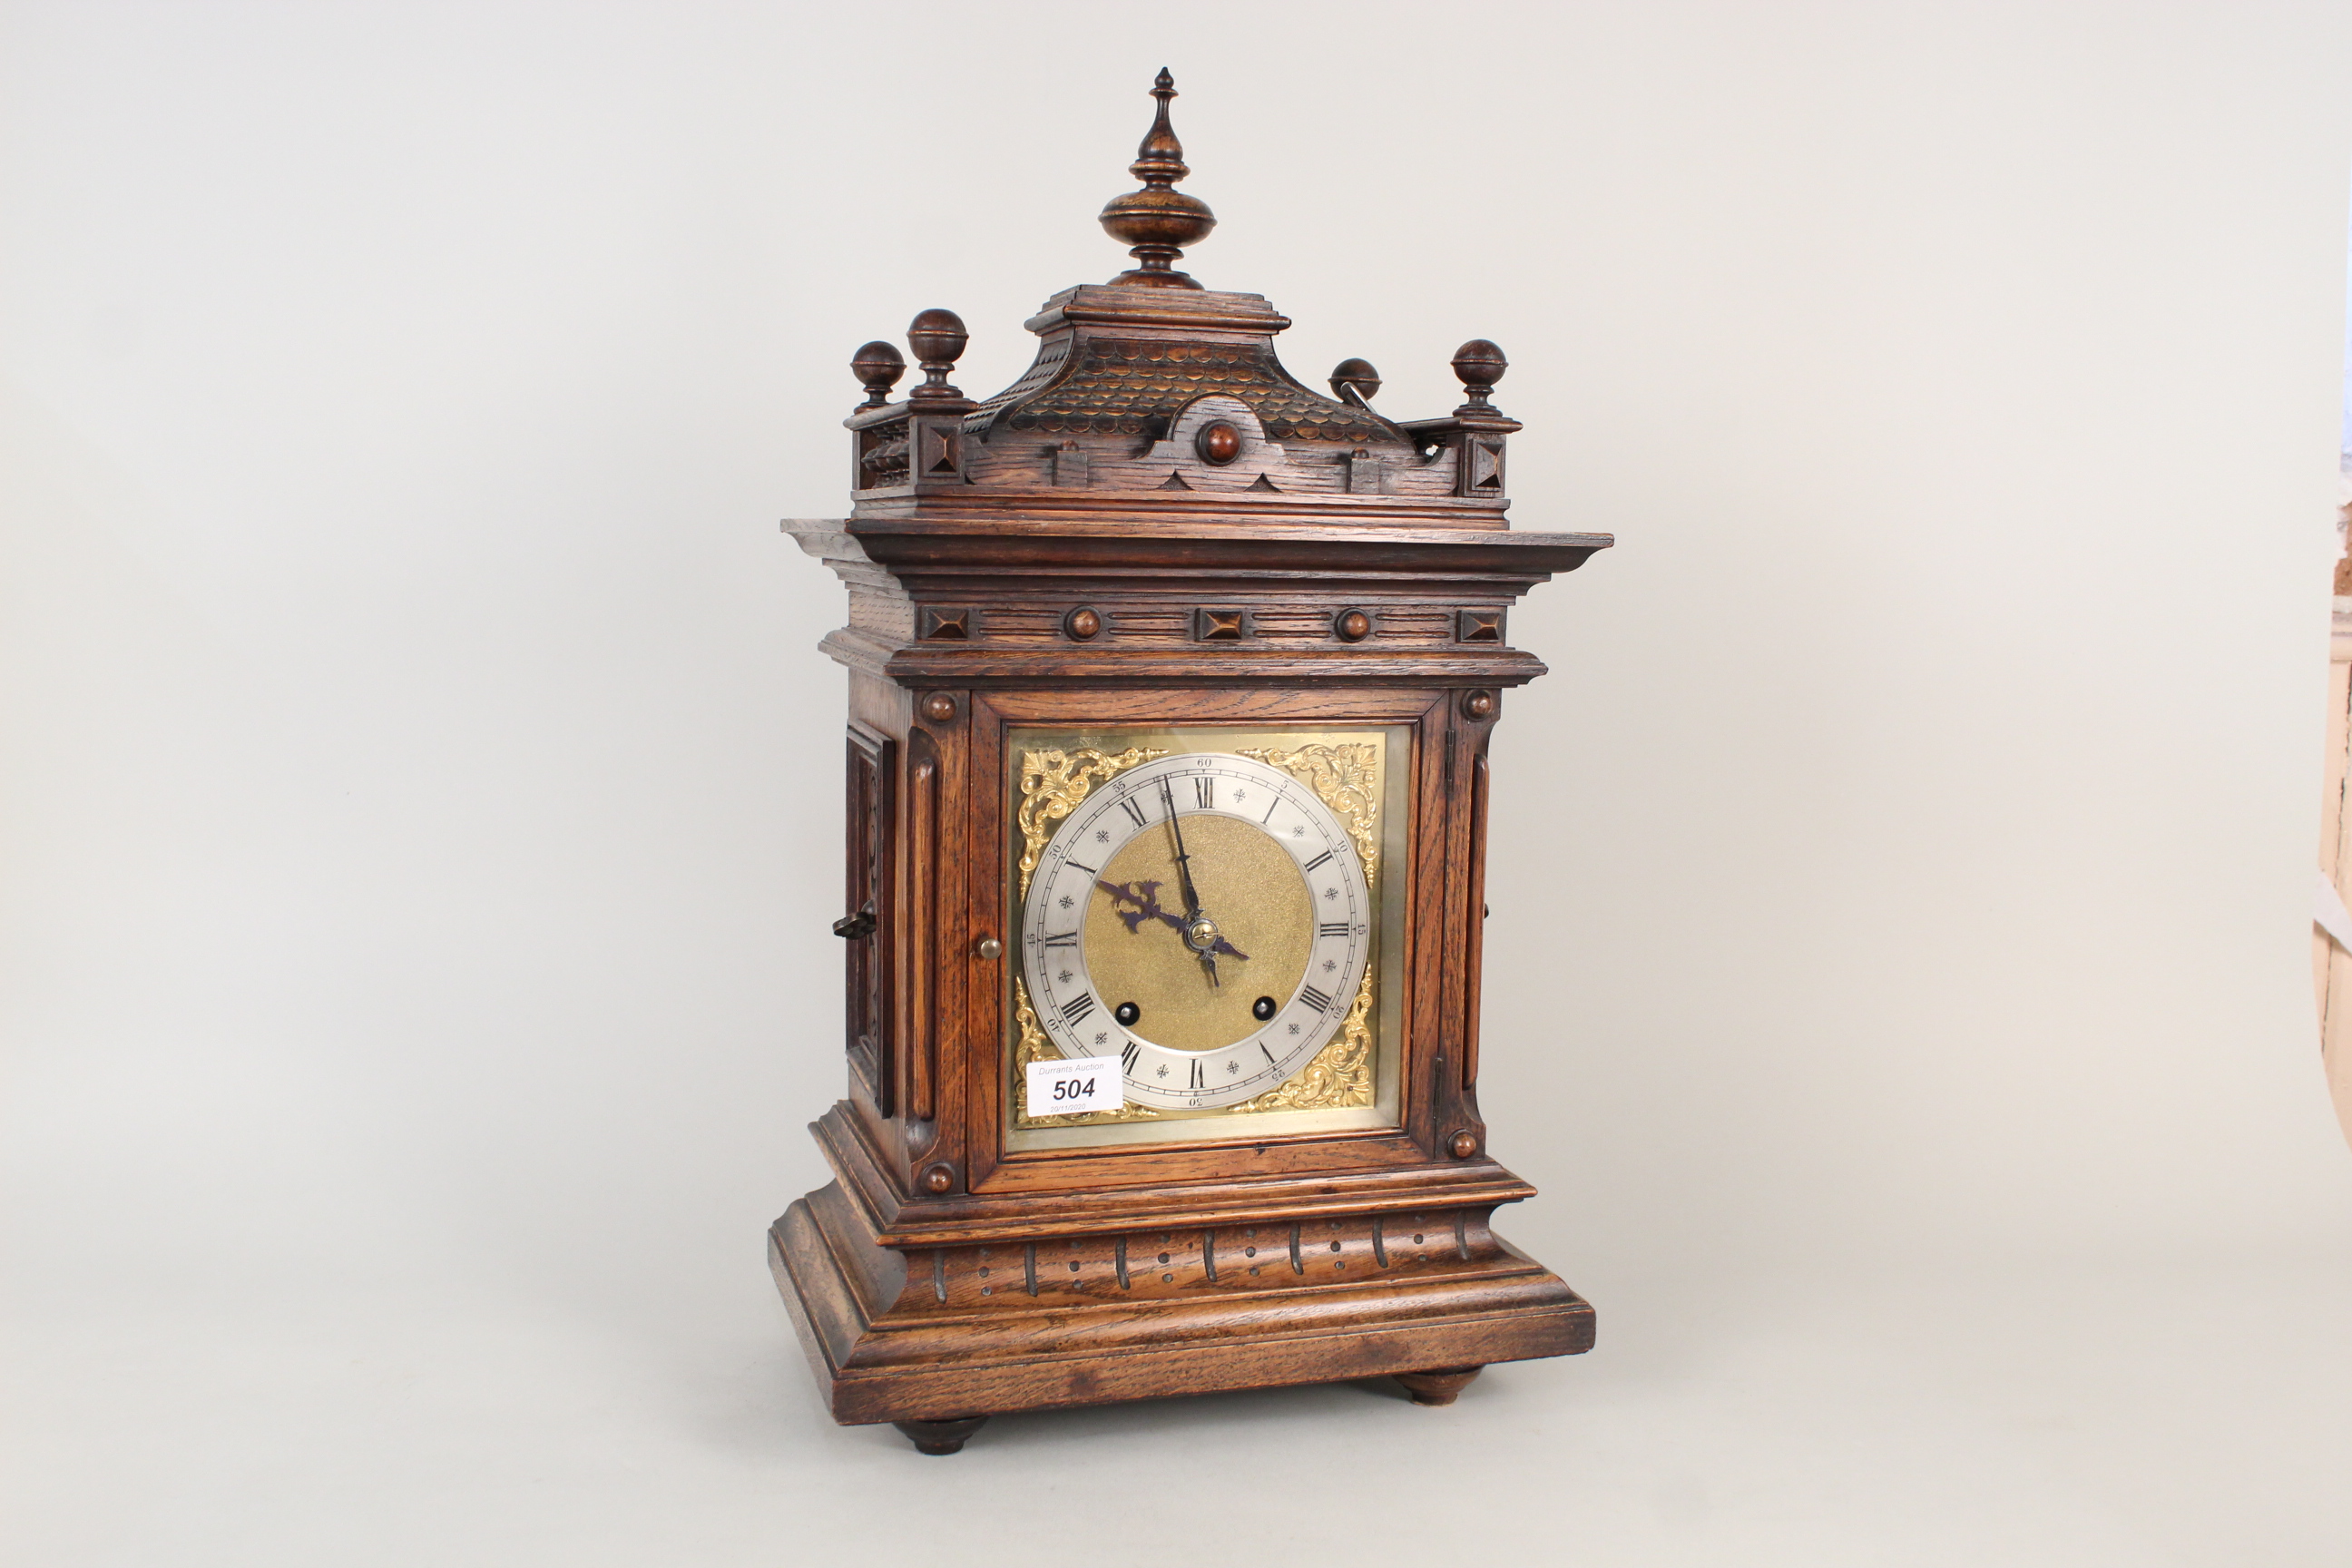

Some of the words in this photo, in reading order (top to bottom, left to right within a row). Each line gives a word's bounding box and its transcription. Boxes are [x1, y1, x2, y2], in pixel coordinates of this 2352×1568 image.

[1197, 758, 1212, 768] 60
[1112, 780, 1126, 793] 55
[1280, 779, 1289, 789] 5
[1192, 777, 1216, 809] XII
[1117, 794, 1151, 832] XI
[1048, 843, 1062, 860] 50
[1336, 840, 1348, 853] 10
[1063, 852, 1099, 882] X
[1302, 846, 1335, 876] II
[1319, 920, 1349, 940] III
[1357, 923, 1367, 936] 15
[1026, 933, 1035, 948] 45
[1044, 928, 1078, 951] IX
[1298, 983, 1333, 1015] IIII
[1060, 987, 1096, 1029] VIII
[1332, 1004, 1345, 1020] 20
[1046, 1017, 1061, 1033] 40
[1258, 1039, 1278, 1067] V
[1038, 1066, 1073, 1075] Durrants
[1074, 1063, 1104, 1072] Auction
[1188, 1058, 1206, 1089] VI
[1271, 1069, 1286, 1082] 25
[1053, 1077, 1095, 1101] 504
[1050, 1102, 1086, 1113] 20/11/2020
[1189, 1097, 1204, 1107] 30
